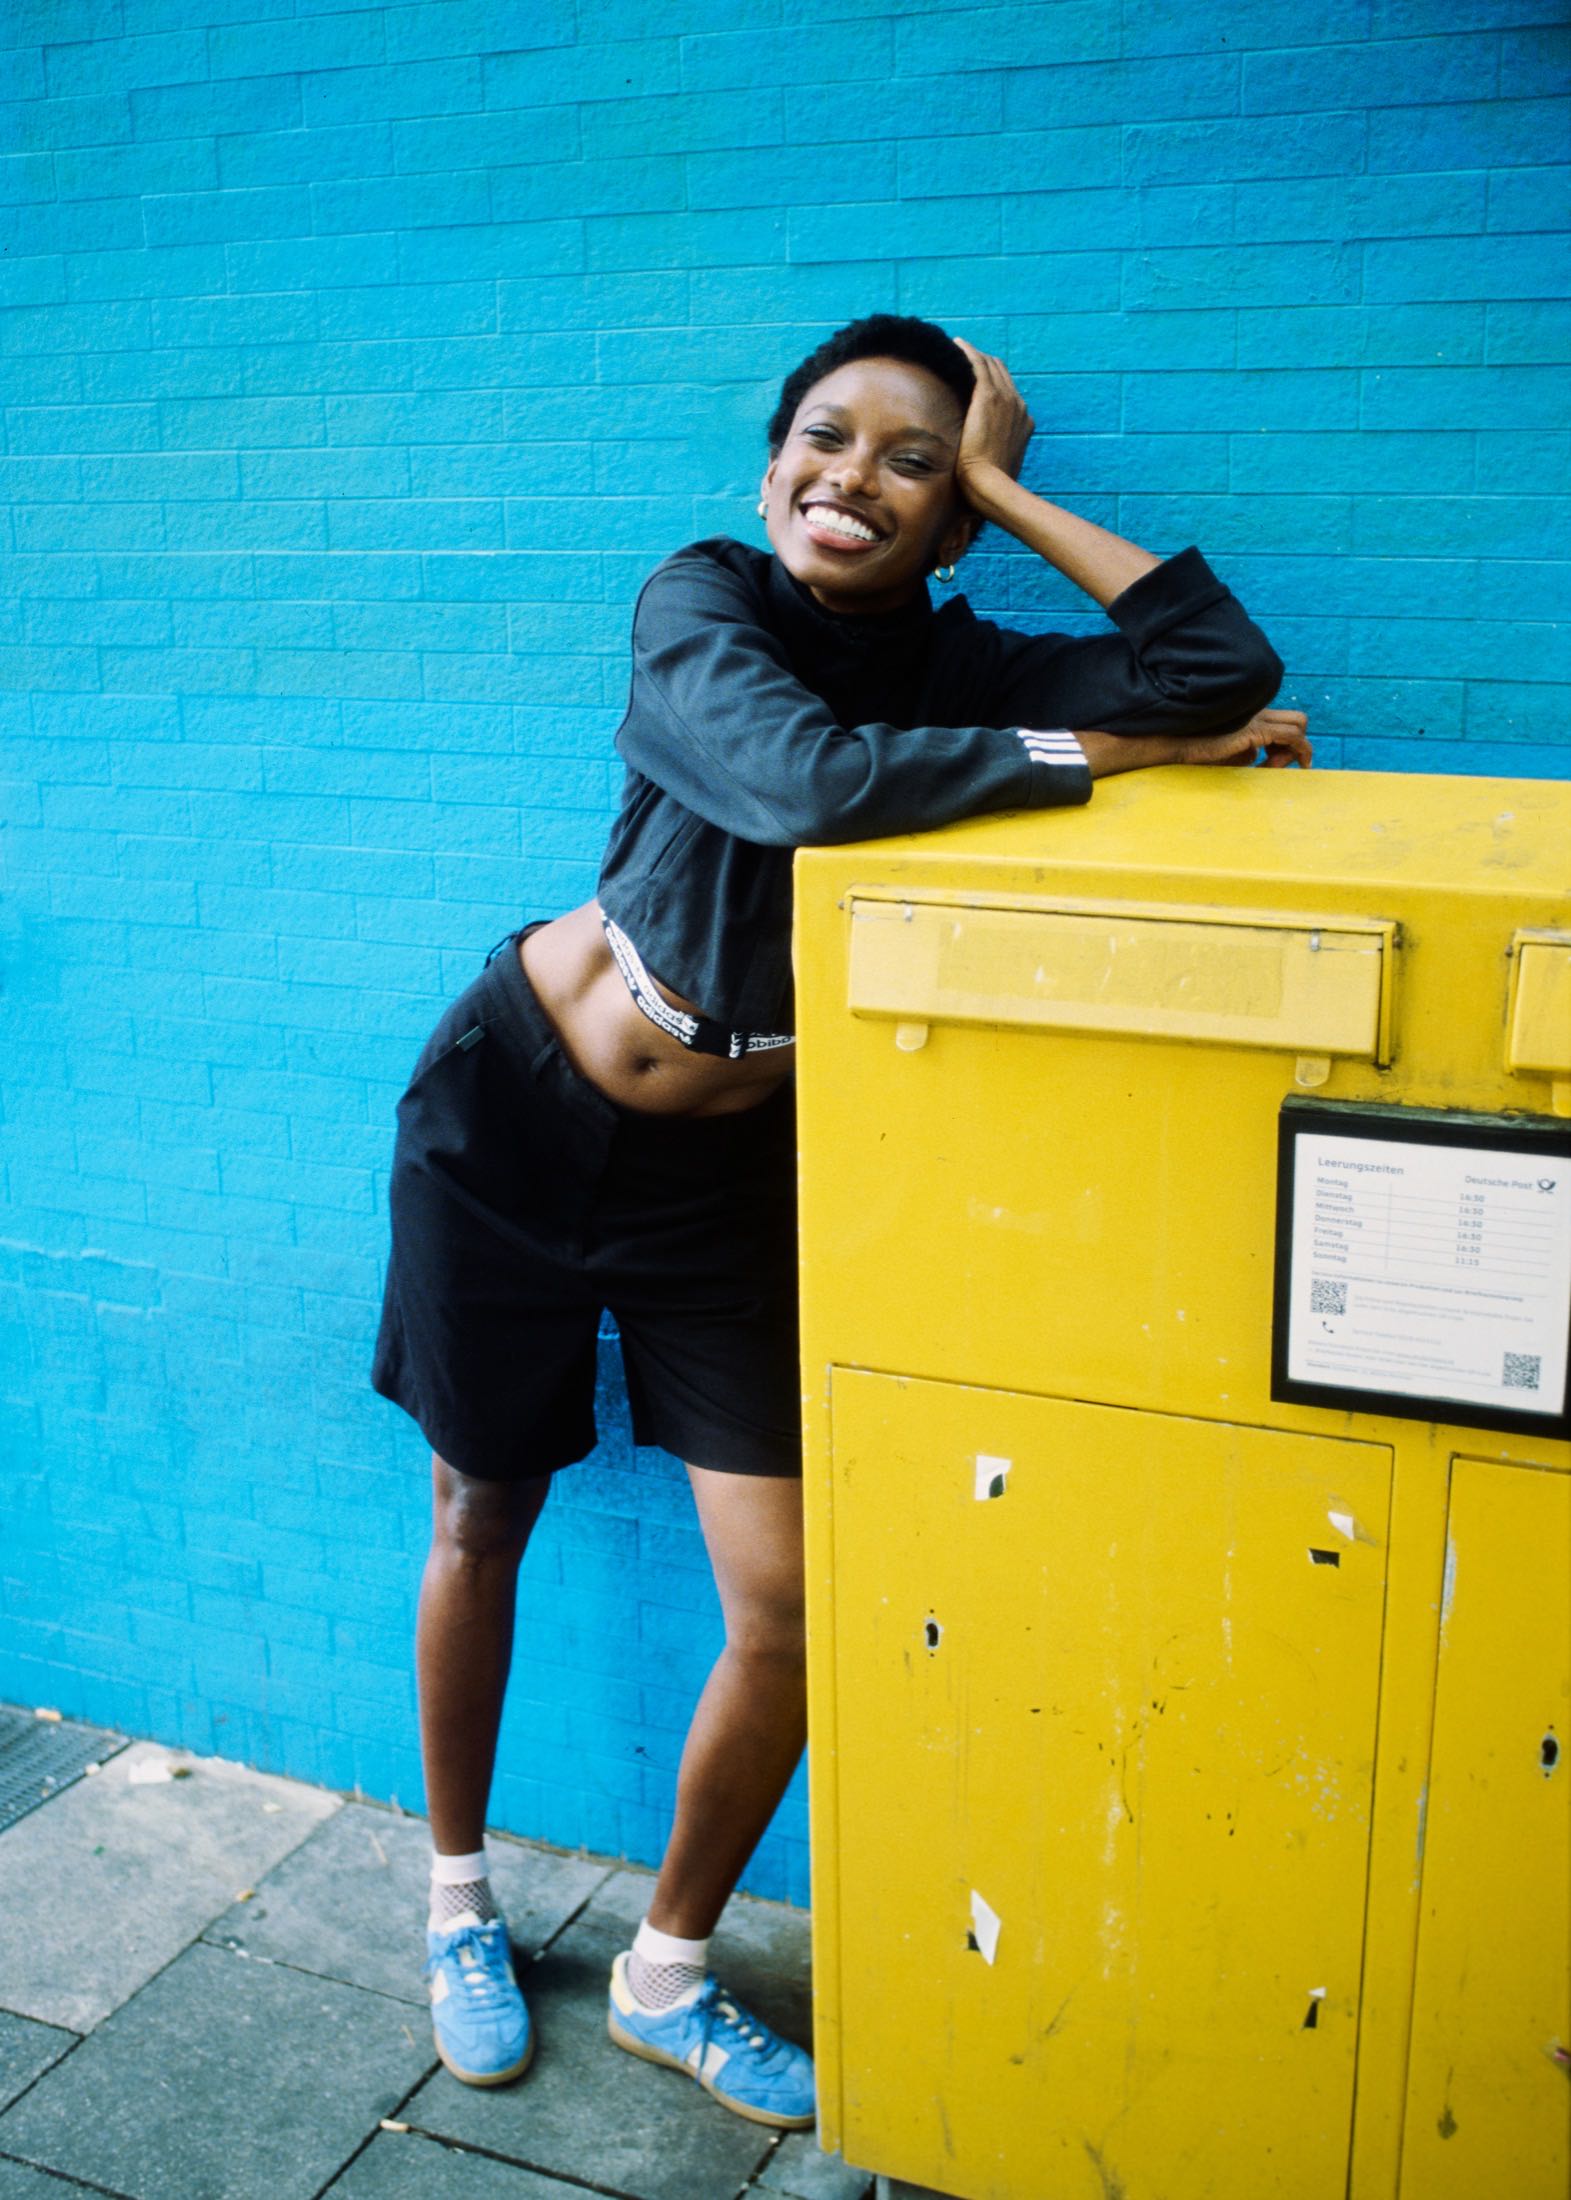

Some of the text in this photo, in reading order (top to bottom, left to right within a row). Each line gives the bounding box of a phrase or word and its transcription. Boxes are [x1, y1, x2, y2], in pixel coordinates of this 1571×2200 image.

[636, 994, 681, 1038] adidas
[1317, 1156, 1404, 1175] Leerungszeiten
[1317, 1177, 1349, 1188] Montag
[1465, 1176, 1533, 1190] Deutsche Post
[1315, 1189, 1353, 1201] Dienstag
[1315, 1202, 1355, 1213] Mittwoch
[1314, 1214, 1362, 1228] Donnerstag
[1314, 1226, 1344, 1238] Freitag
[1313, 1239, 1349, 1251] Samstag
